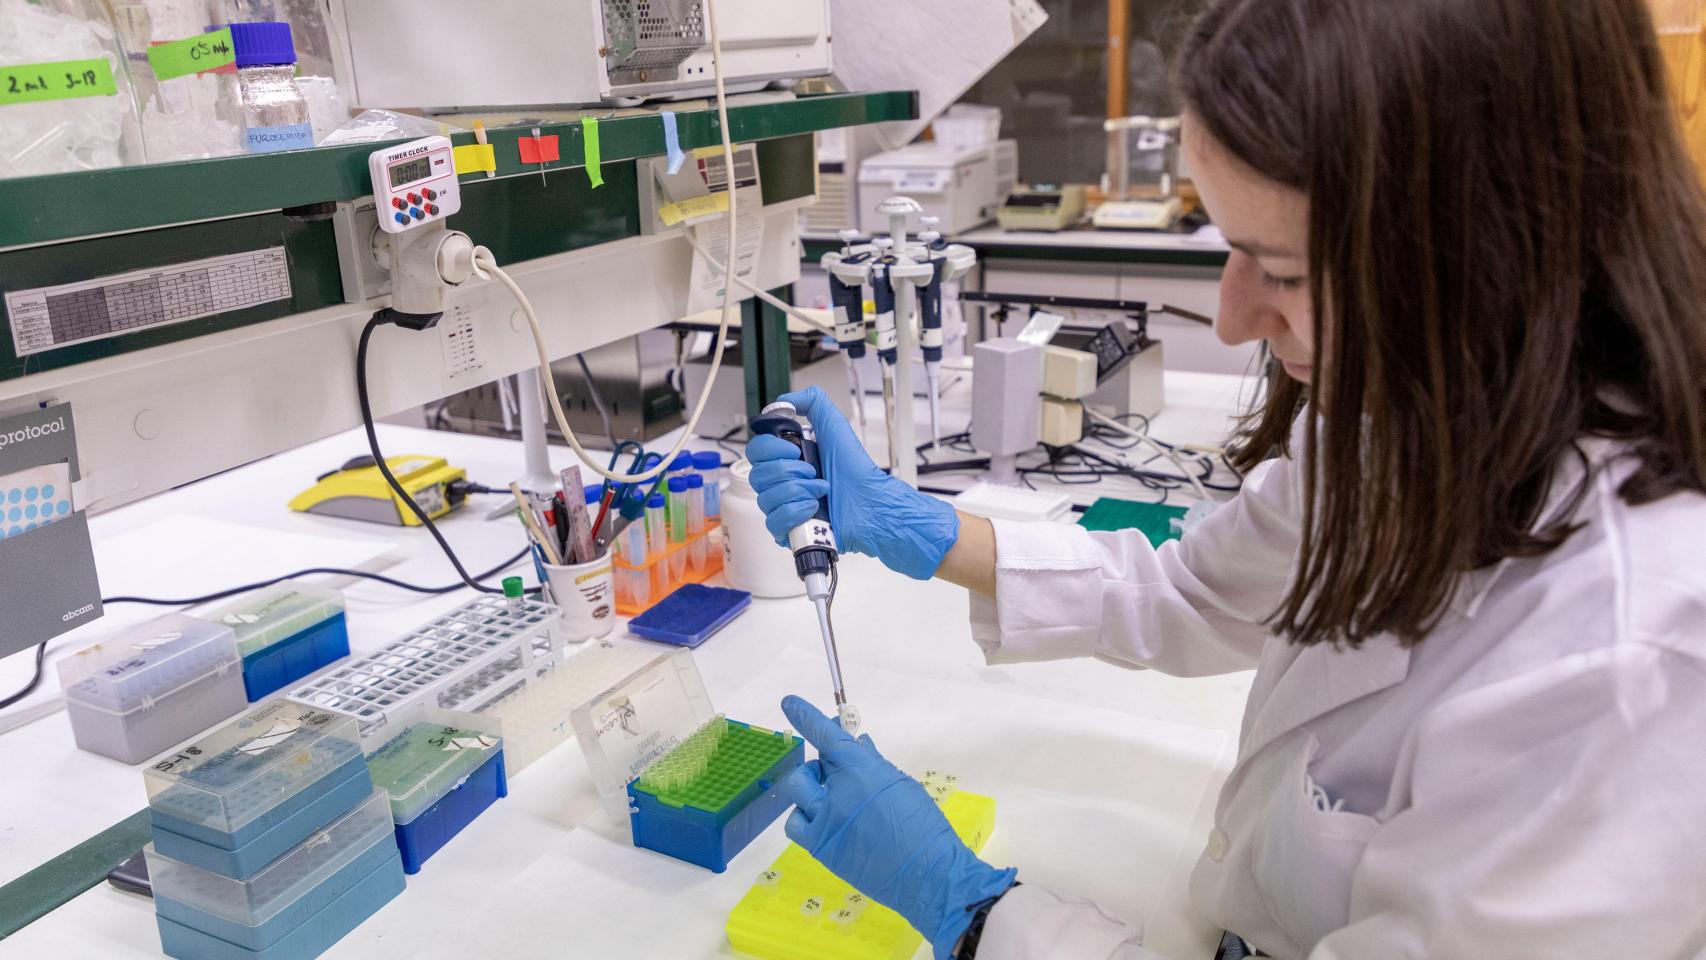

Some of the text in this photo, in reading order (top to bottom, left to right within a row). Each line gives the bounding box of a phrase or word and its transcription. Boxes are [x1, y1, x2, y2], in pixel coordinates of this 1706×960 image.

[8, 75, 22, 93] 2
[387, 146, 429, 162] TIMER CLOCK
[62, 603, 94, 622] abcam
[297, 710, 315, 722] Tips
[155, 746, 203, 772] S-18
